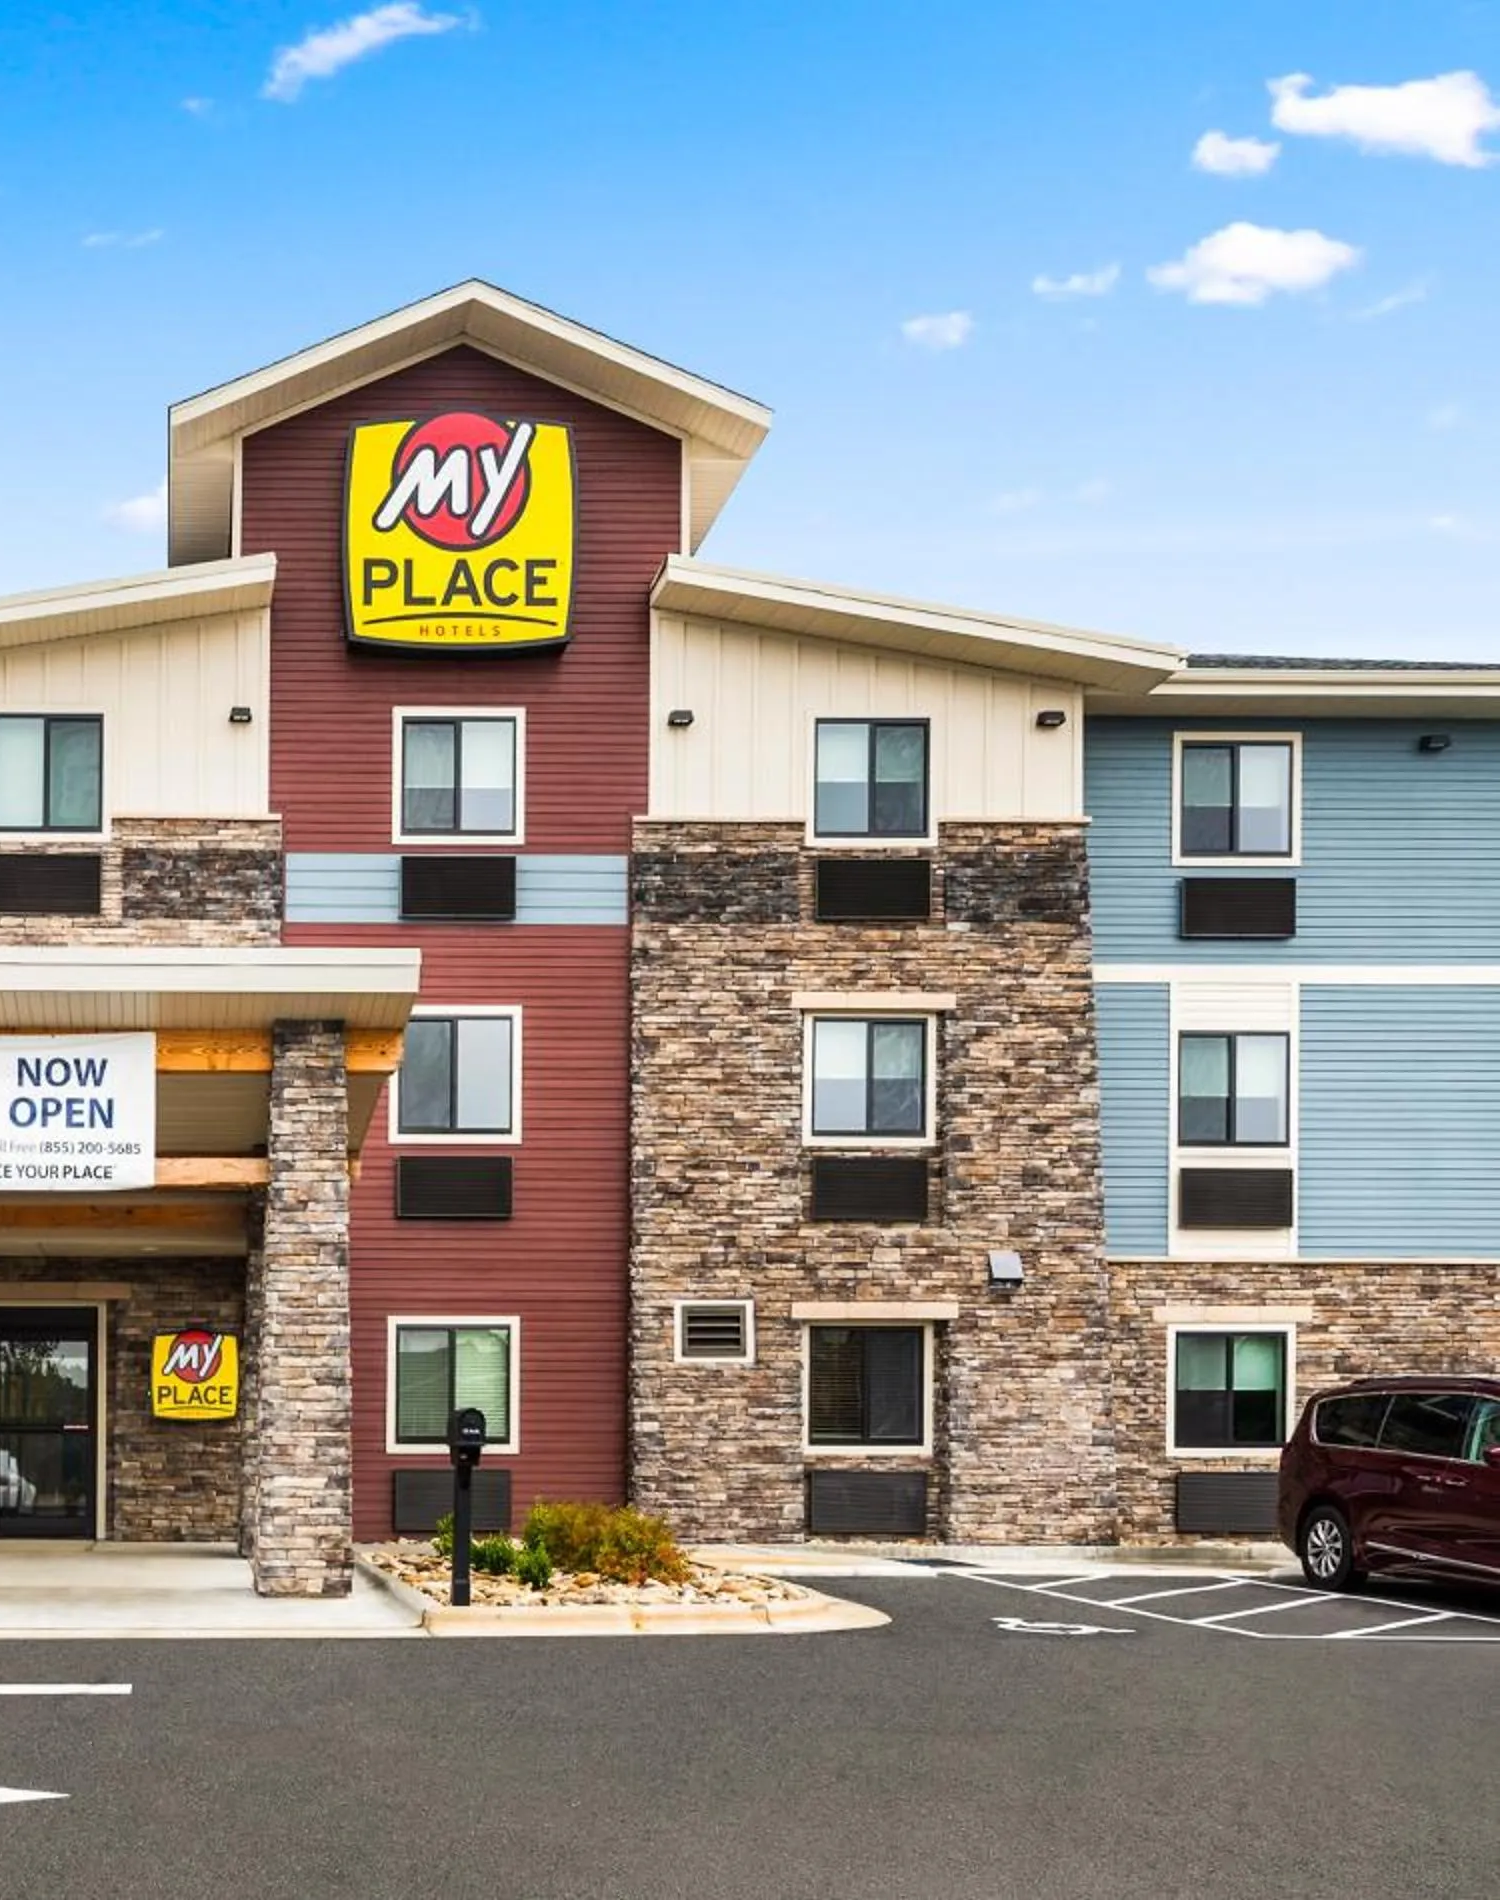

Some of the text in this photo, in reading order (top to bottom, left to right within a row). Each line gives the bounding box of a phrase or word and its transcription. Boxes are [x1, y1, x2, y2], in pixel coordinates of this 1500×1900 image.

[361, 558, 558, 607] PLACE
[418, 624, 502, 638] HOTELS
[16, 1057, 109, 1087] NOW
[8, 1097, 115, 1129] OPEN
[39, 1140, 74, 1155] (855)
[77, 1141, 142, 1156] 200-5685
[15, 1164, 59, 1179] YOUR
[62, 1165, 114, 1180] PLACE
[156, 1385, 233, 1405] PLACE
